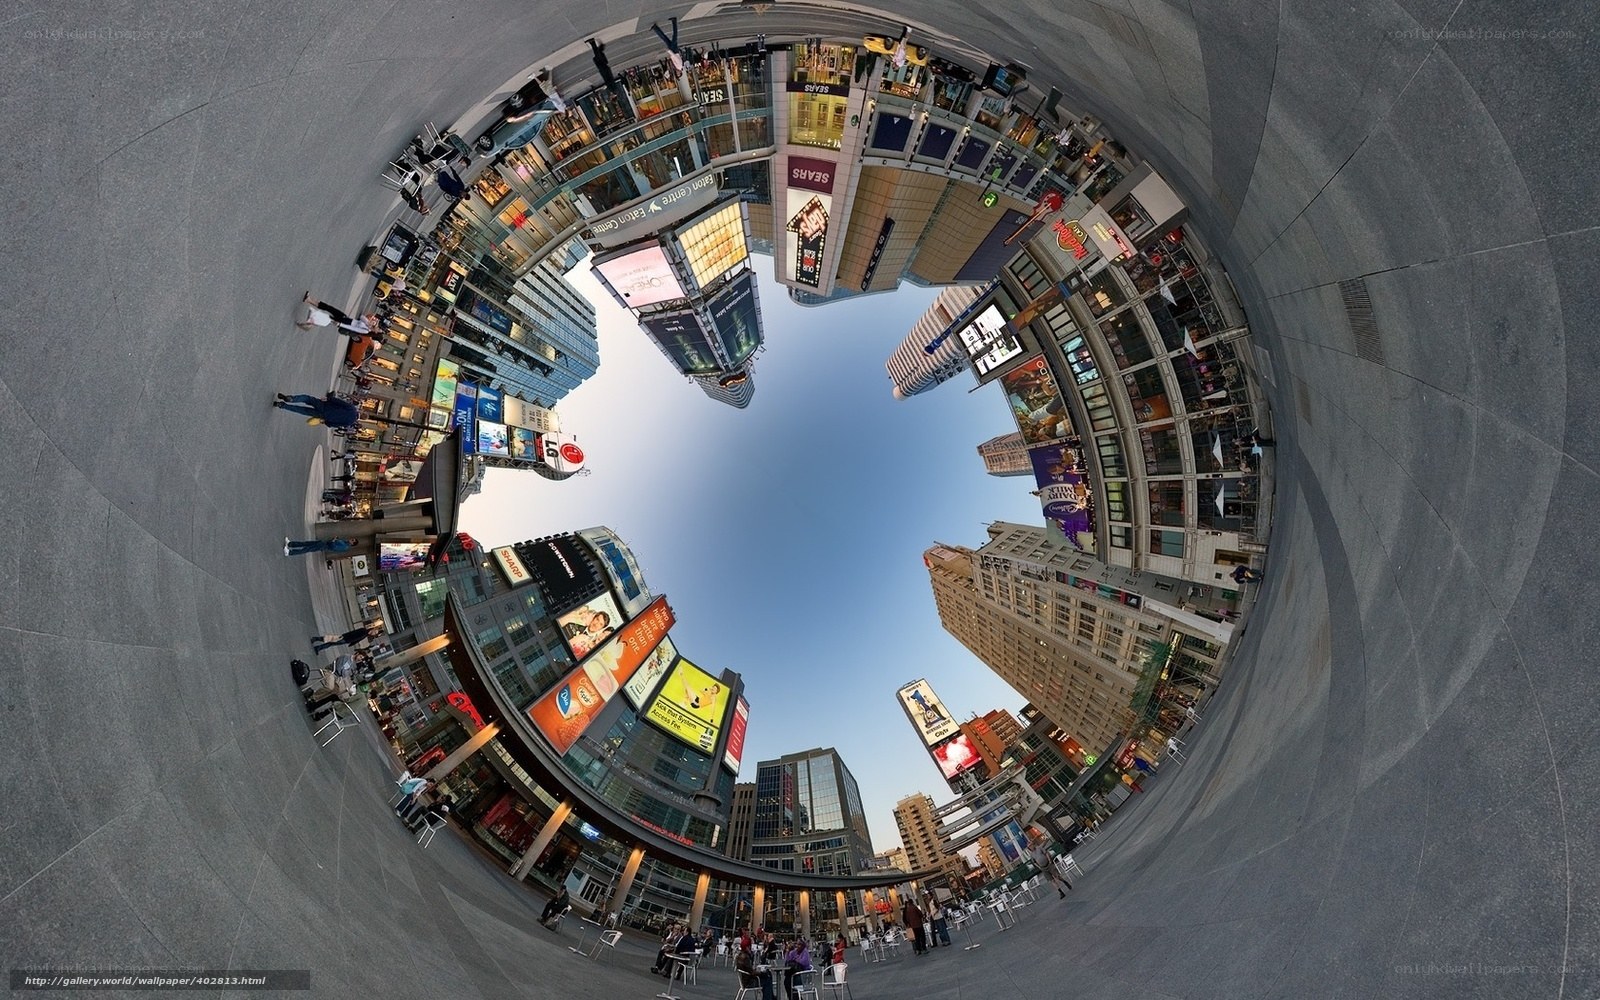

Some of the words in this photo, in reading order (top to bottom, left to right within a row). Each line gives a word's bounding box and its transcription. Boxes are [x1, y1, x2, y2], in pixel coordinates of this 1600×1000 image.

[804, 84, 830, 94] SEARS
[692, 174, 714, 190] Eaton
[792, 168, 830, 184] SEARS
[662, 186, 692, 204] Centre
[620, 208, 646, 224] Eaton
[800, 208, 826, 238] days
[593, 219, 618, 234] Centre
[1052, 218, 1073, 242] Rock
[1064, 234, 1088, 260] Hard
[1036, 360, 1054, 388] ALDO
[545, 440, 558, 458] LG
[1046, 492, 1078, 502] DAIRY
[500, 550, 523, 578] SHARP
[548, 542, 576, 579] DOWNTOWN
[654, 608, 666, 630] halves
[660, 606, 670, 622] Two
[640, 618, 655, 642] better
[650, 620, 658, 630] are
[628, 638, 640, 655] one.
[634, 628, 648, 648] than
[650, 708, 671, 726] Access
[670, 720, 682, 731] Fee.
[656, 702, 668, 714] Kick
[668, 709, 678, 720] that
[677, 713, 696, 730] System
